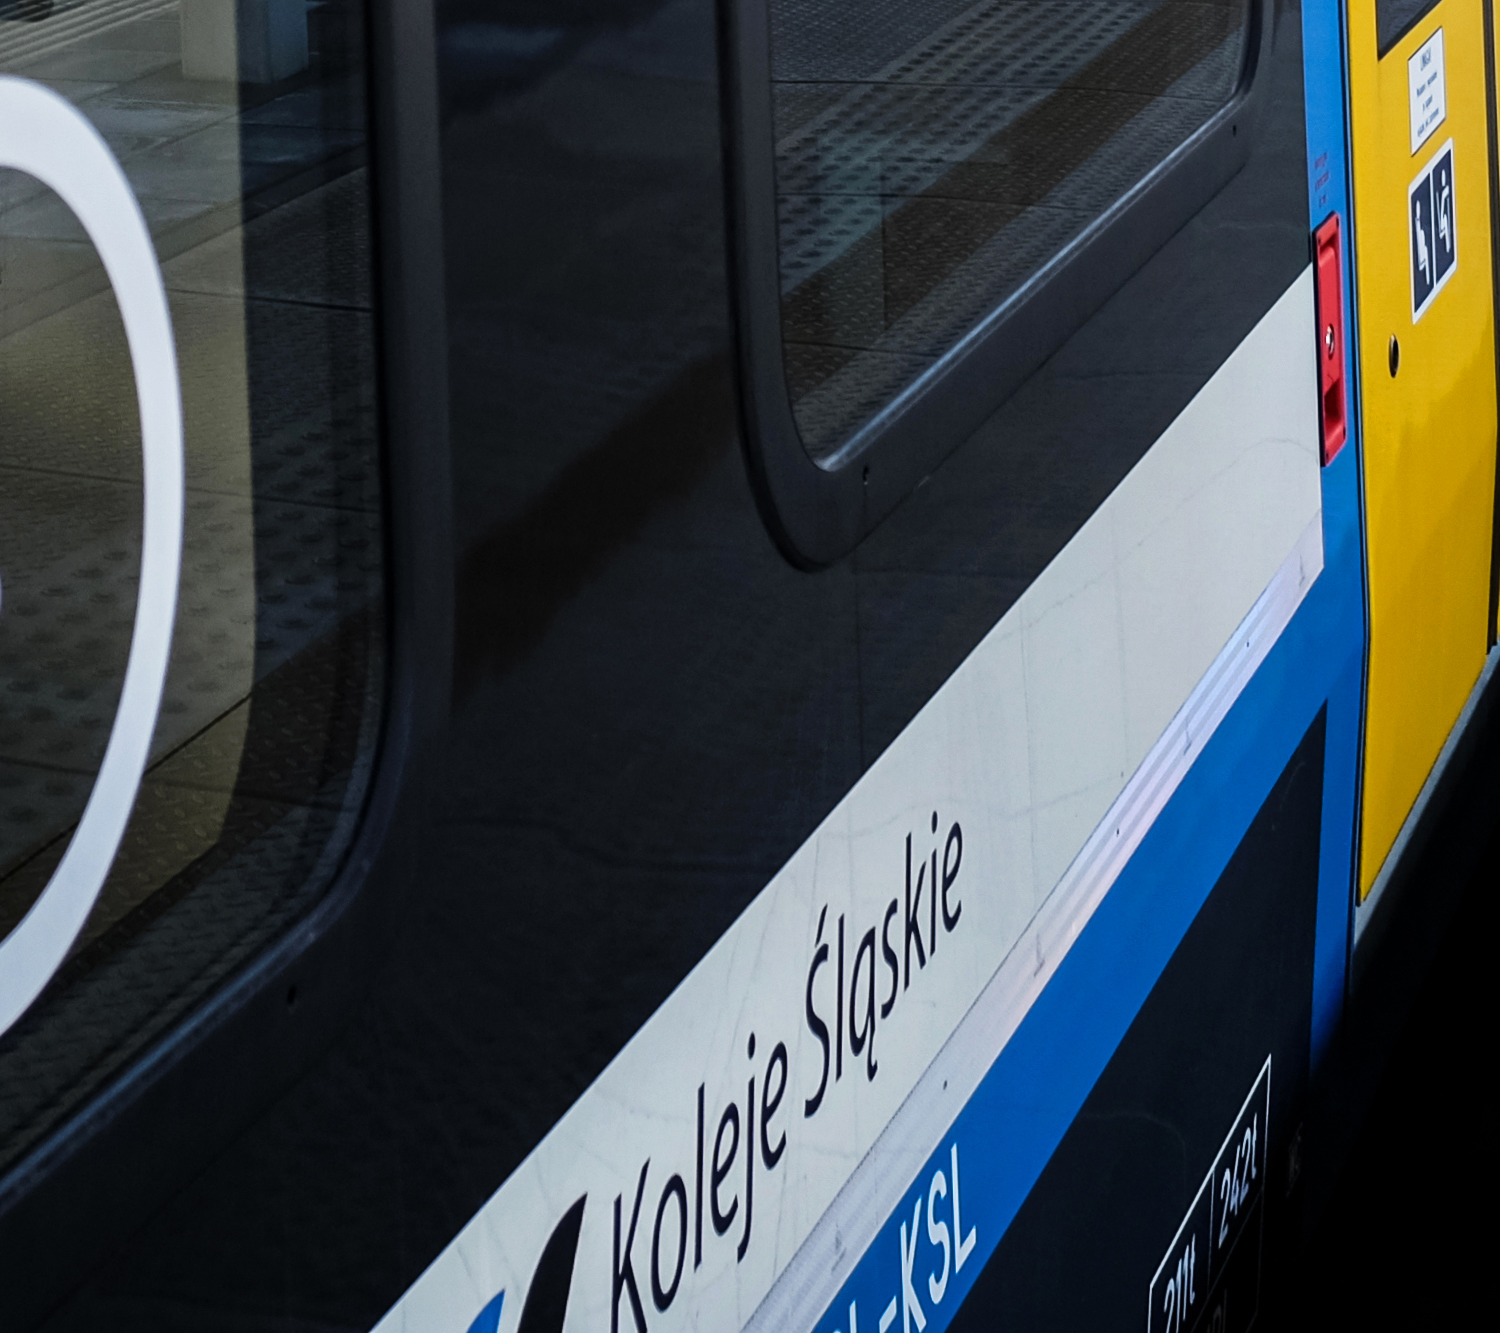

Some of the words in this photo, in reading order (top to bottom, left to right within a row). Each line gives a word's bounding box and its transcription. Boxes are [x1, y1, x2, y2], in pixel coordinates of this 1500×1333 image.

[610, 1031, 788, 1333] Koleje
[803, 810, 963, 1119] Śląskie
[831, 1143, 976, 1333] -KSL
